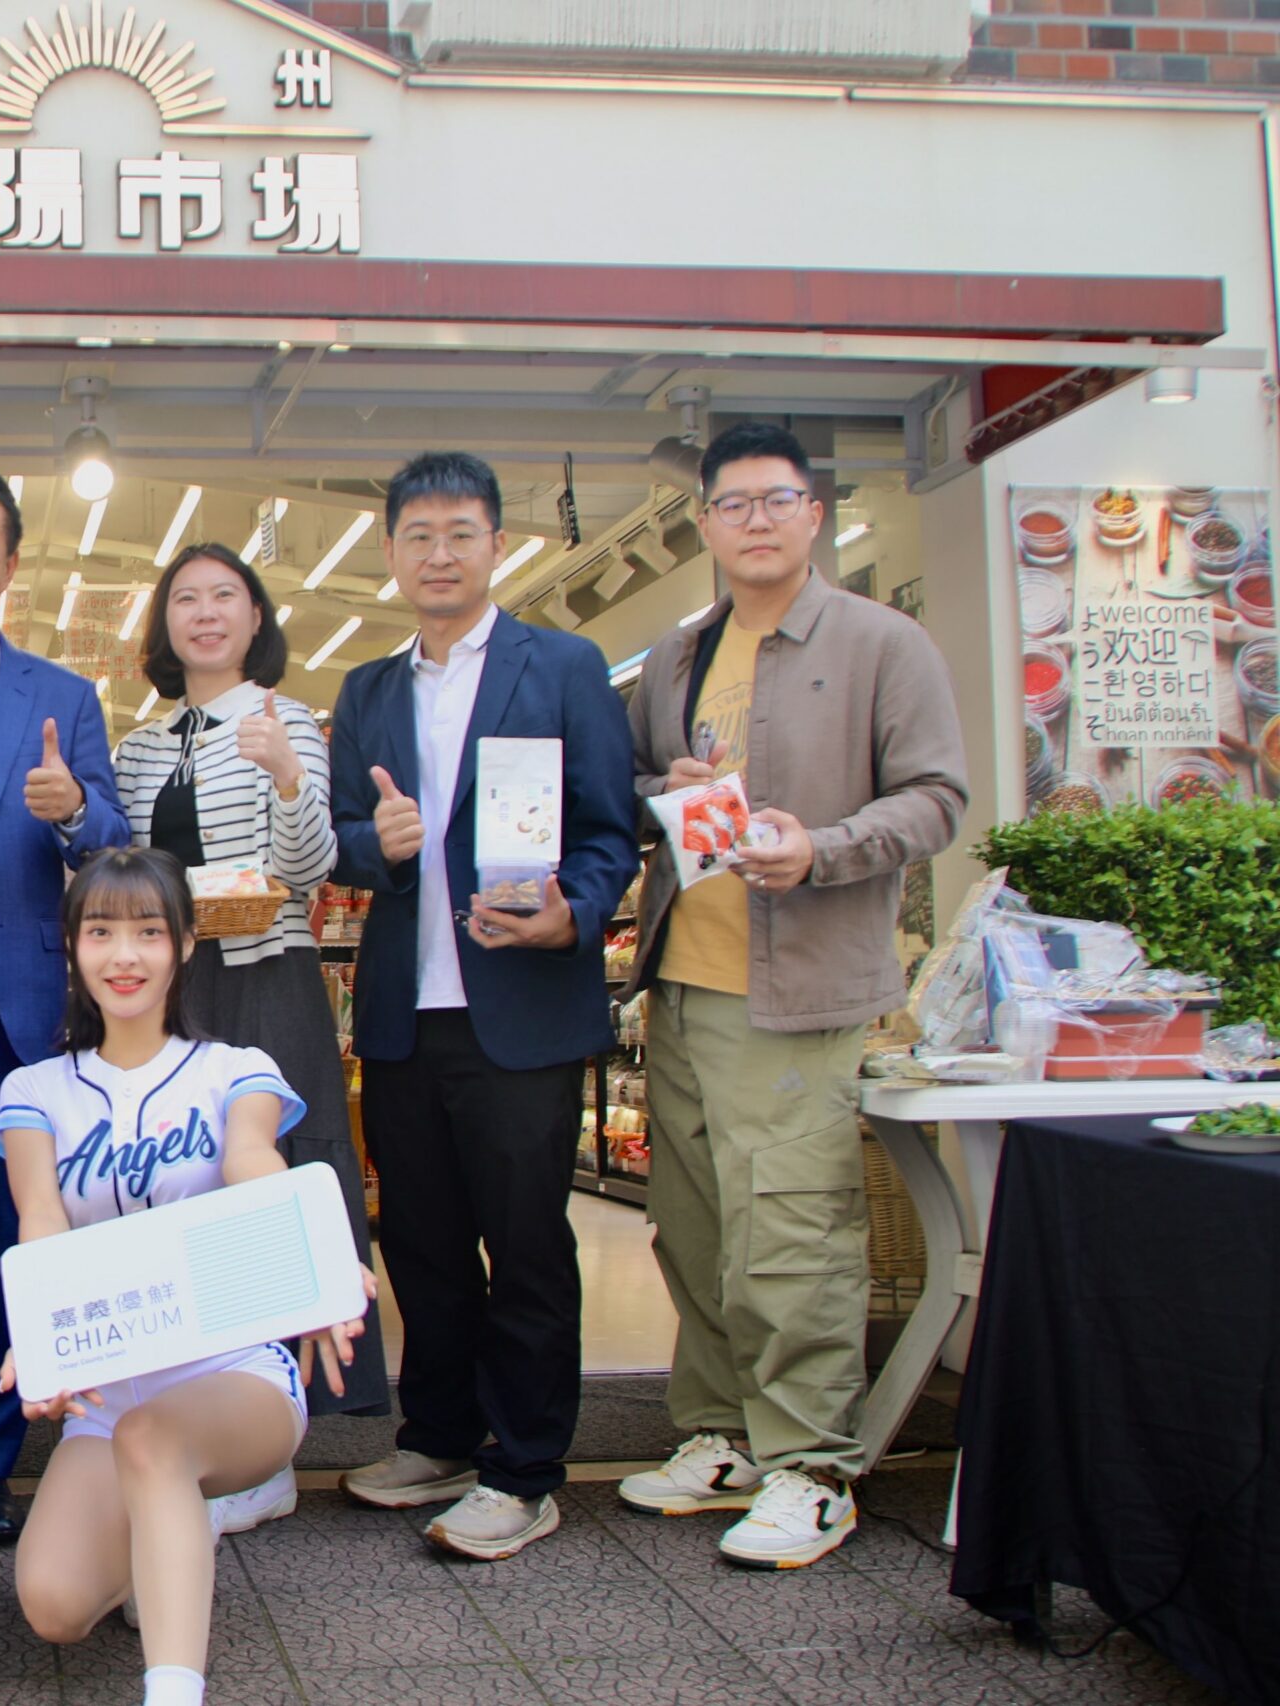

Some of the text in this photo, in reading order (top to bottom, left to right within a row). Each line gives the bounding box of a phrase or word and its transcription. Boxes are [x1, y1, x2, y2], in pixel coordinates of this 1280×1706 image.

[275, 47, 333, 108] 州
[1102, 627, 1179, 666] 欢迎
[1082, 605, 1105, 742] ようこそ
[1103, 669, 1213, 698] 환영하다
[58, 1106, 218, 1200] Angels
[50, 1281, 178, 1331] 嘉義優鮮
[54, 1305, 184, 1357] CHIAYUM
